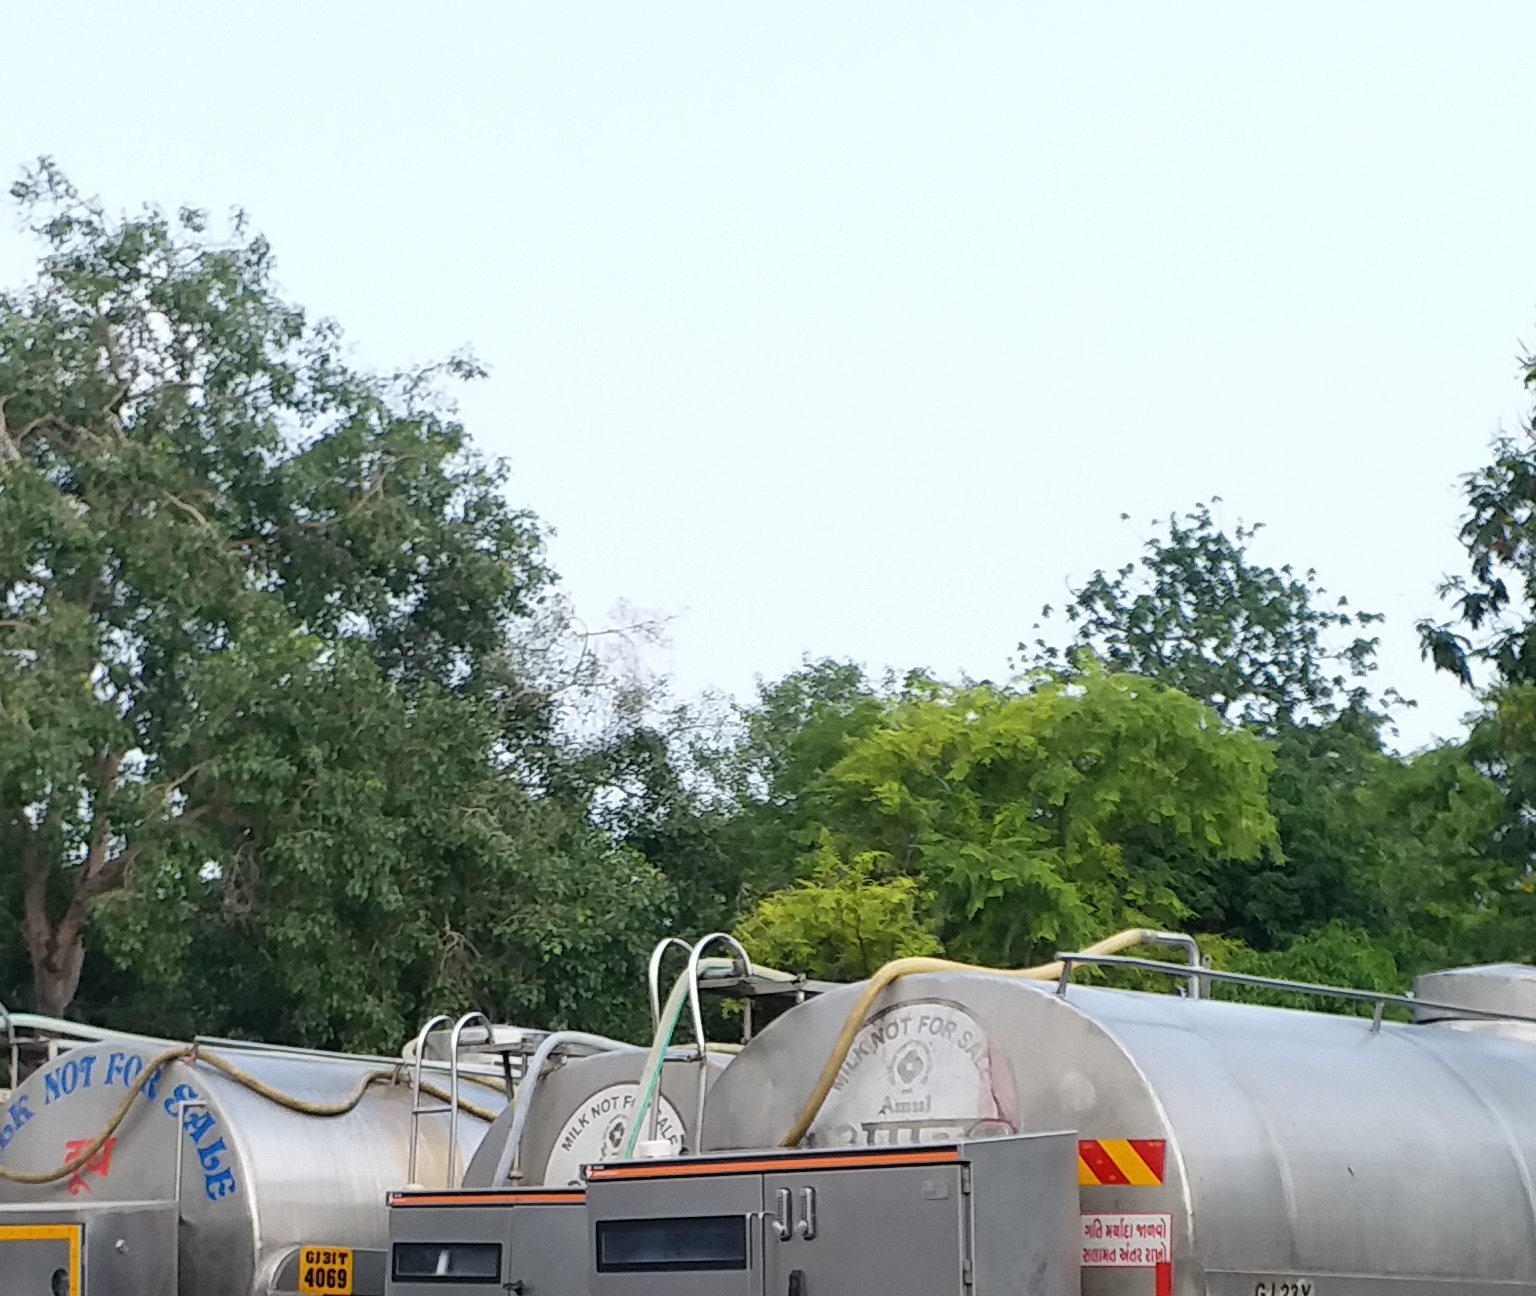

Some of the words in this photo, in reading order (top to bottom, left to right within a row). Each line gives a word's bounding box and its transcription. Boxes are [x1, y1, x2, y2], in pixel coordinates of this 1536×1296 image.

[833, 1042, 870, 1092] MILK
[870, 1018, 911, 1049] NOT
[918, 1015, 958, 1040] FOR
[43, 1055, 97, 1105] NOT
[163, 1083, 236, 1201] SALE
[561, 1113, 591, 1152] MILK
[590, 1096, 620, 1119] NOT
[656, 1108, 679, 1146] ALE
[304, 1267, 348, 1290] 4069
